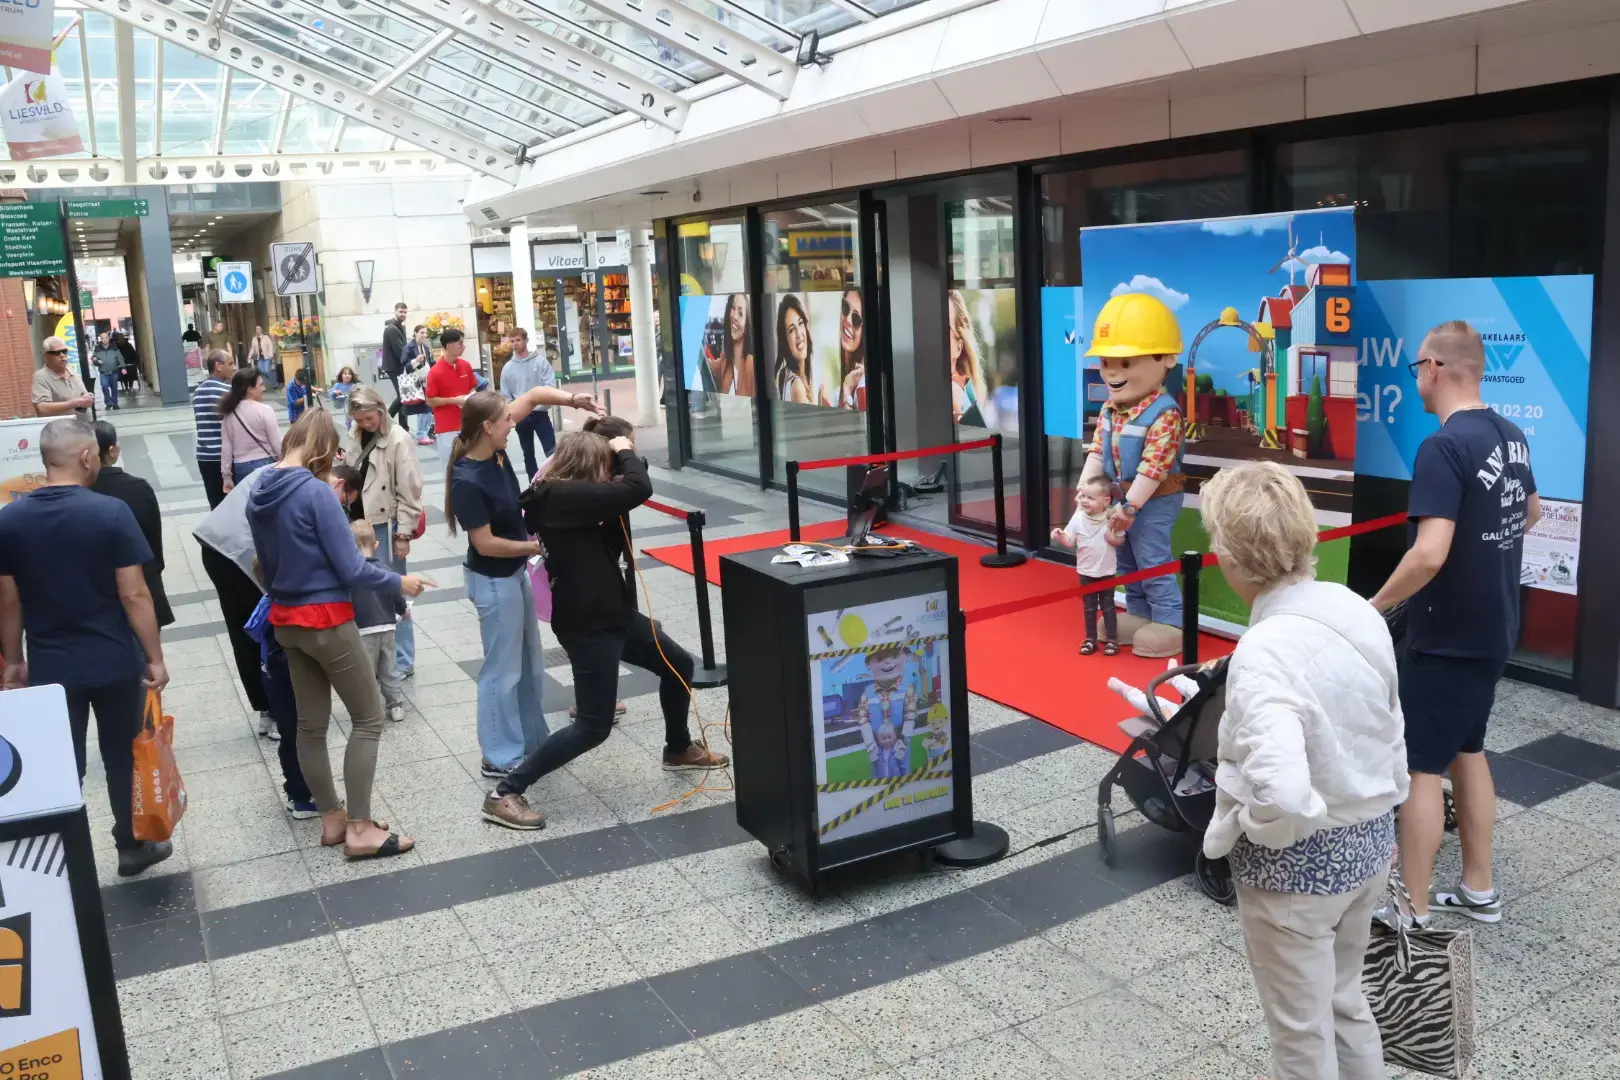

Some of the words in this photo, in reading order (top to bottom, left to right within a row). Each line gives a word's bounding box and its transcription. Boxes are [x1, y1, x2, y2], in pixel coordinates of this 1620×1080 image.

[1503, 404, 1520, 417] 02
[1524, 405, 1543, 419] 20
[19, 1054, 63, 1071] Enco
